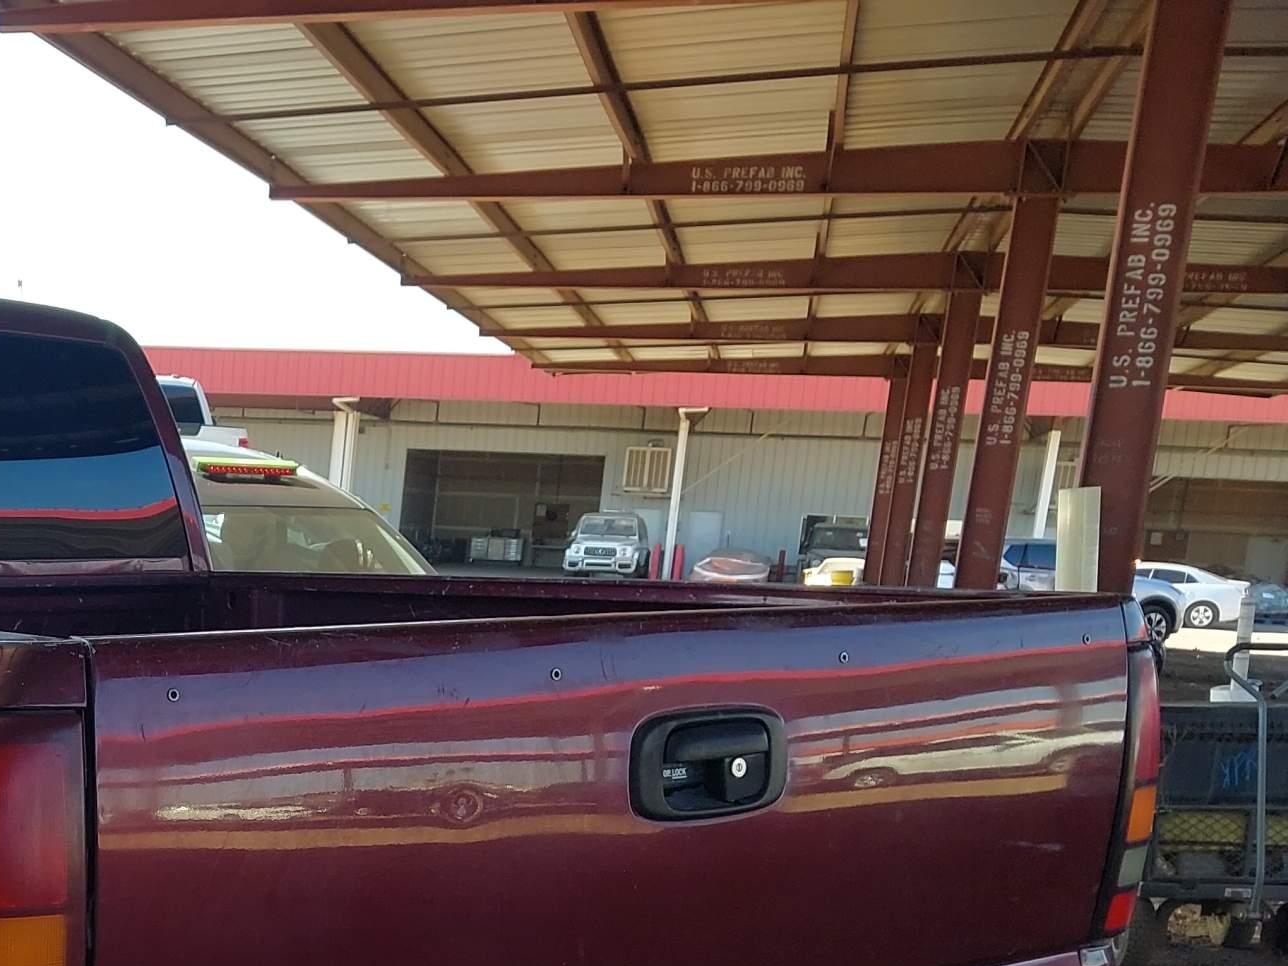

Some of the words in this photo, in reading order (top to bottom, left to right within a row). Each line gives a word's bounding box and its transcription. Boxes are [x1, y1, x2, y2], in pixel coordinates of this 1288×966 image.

[692, 167, 716, 179] U.S.
[723, 166, 775, 179] PREFAB
[781, 166, 807, 178] INC.
[1130, 202, 1156, 244] INC.
[1117, 253, 1146, 336] PREFAB
[1132, 203, 1177, 387] 1-866-799-0969
[991, 361, 1010, 414] PREFAB
[1109, 348, 1133, 388] U.S.
[986, 418, 1001, 446] U.S.
